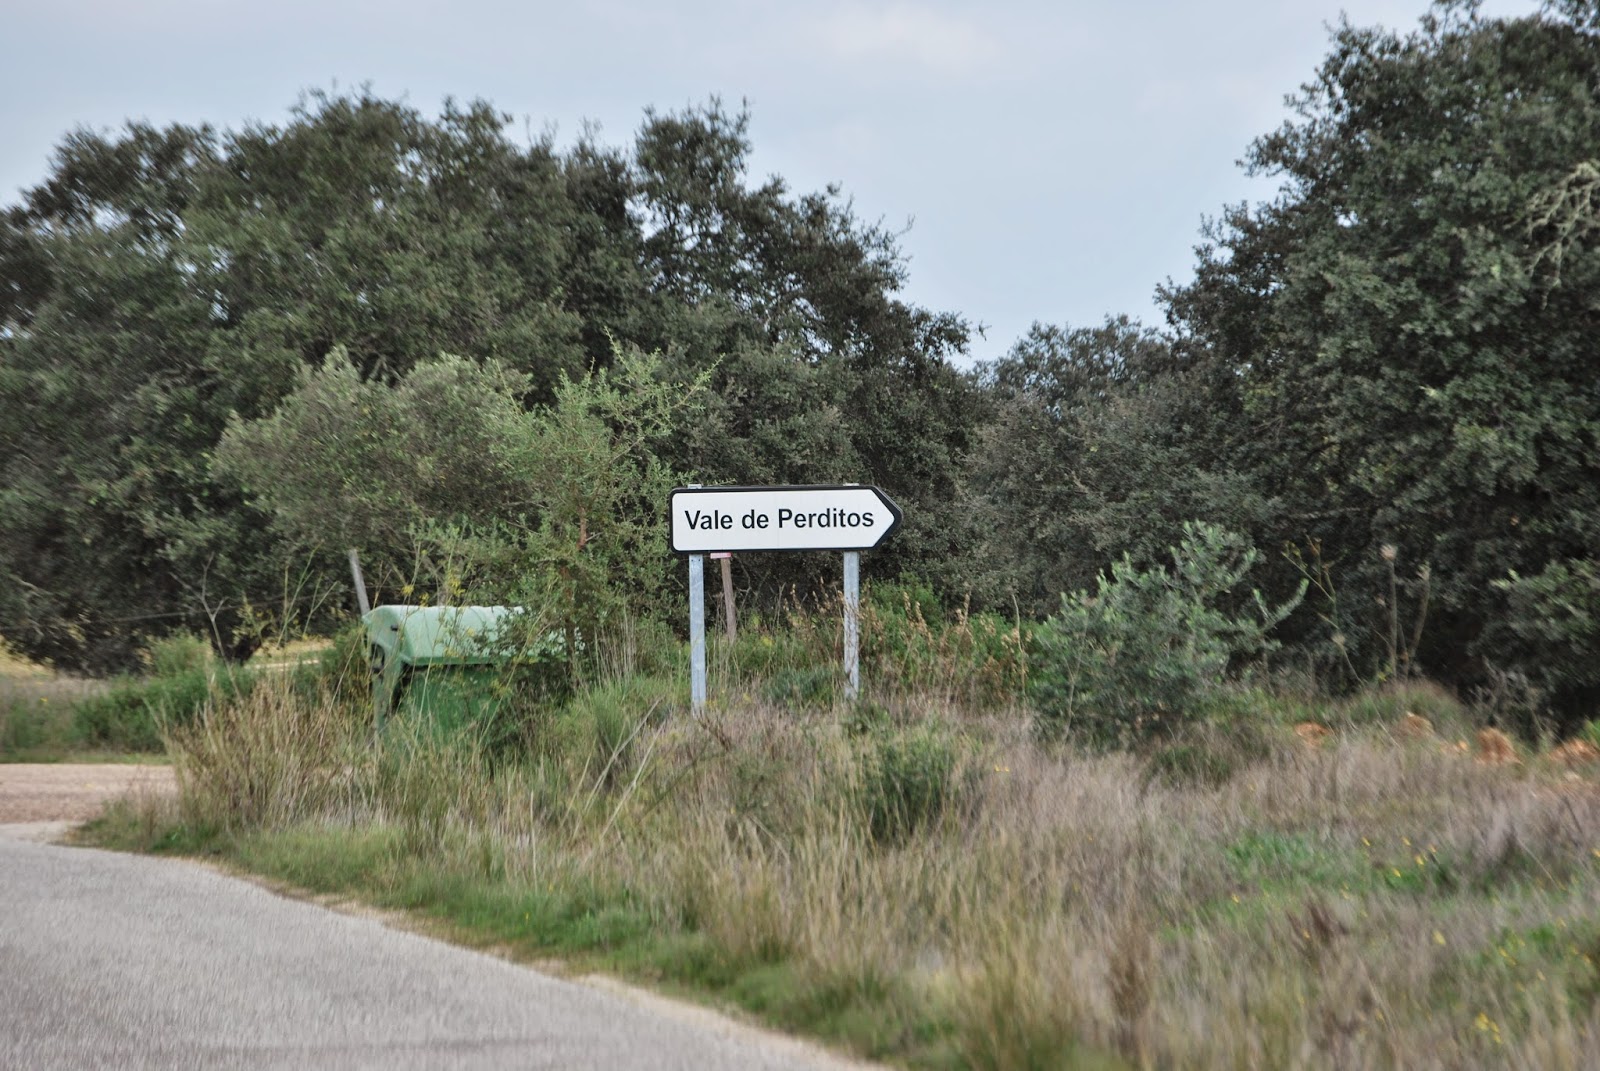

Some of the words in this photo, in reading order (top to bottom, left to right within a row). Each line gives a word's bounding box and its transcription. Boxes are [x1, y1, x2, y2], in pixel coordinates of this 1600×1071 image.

[684, 510, 733, 530] Vale
[741, 509, 769, 529] de
[778, 508, 874, 529] Perditos
